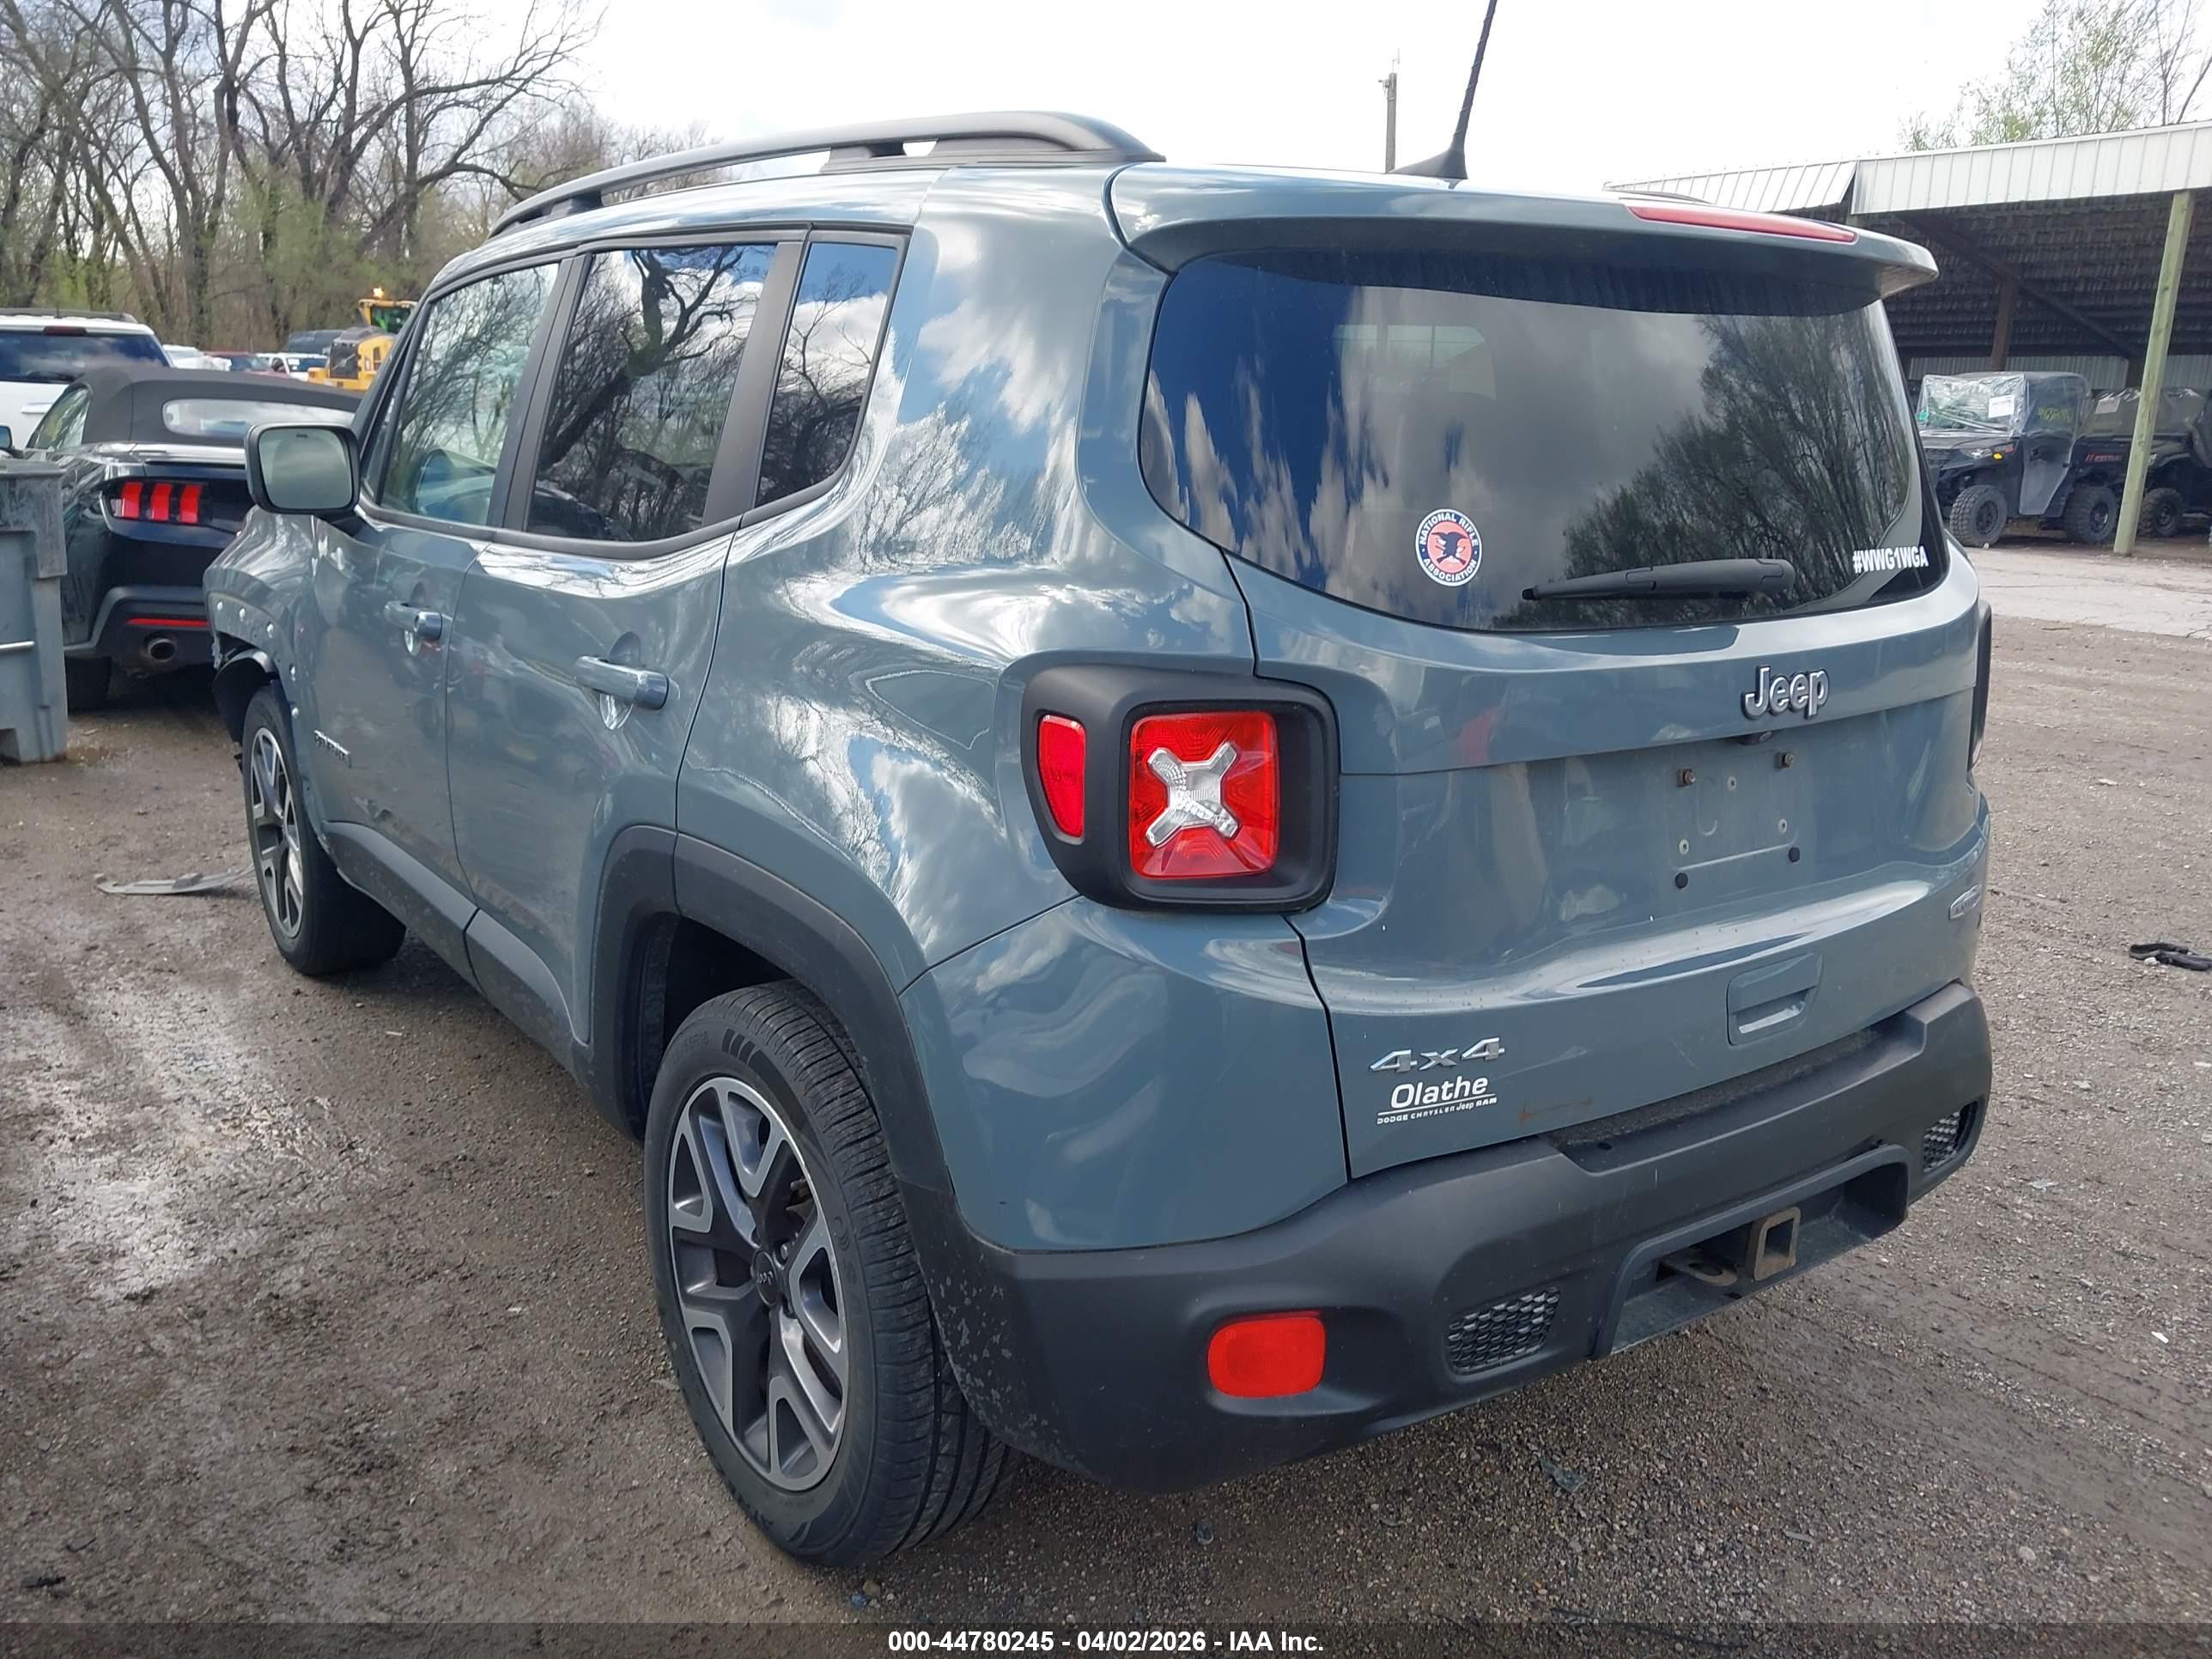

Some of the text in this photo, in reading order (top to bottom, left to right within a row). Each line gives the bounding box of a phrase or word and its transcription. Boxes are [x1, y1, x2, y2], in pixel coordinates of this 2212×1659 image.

[1419, 513, 1479, 547] NATIONAL RIFLE
[1423, 558, 1477, 582] ASSOCIATION
[1852, 545, 1929, 574] #WWG1WGA
[1741, 665, 1830, 720] Jeep
[1369, 1036, 1506, 1073] 4x4
[1390, 1075, 1489, 1109] Olathe
[1376, 1097, 1498, 1125] DODGE CHRYSLER Jeep RAM
